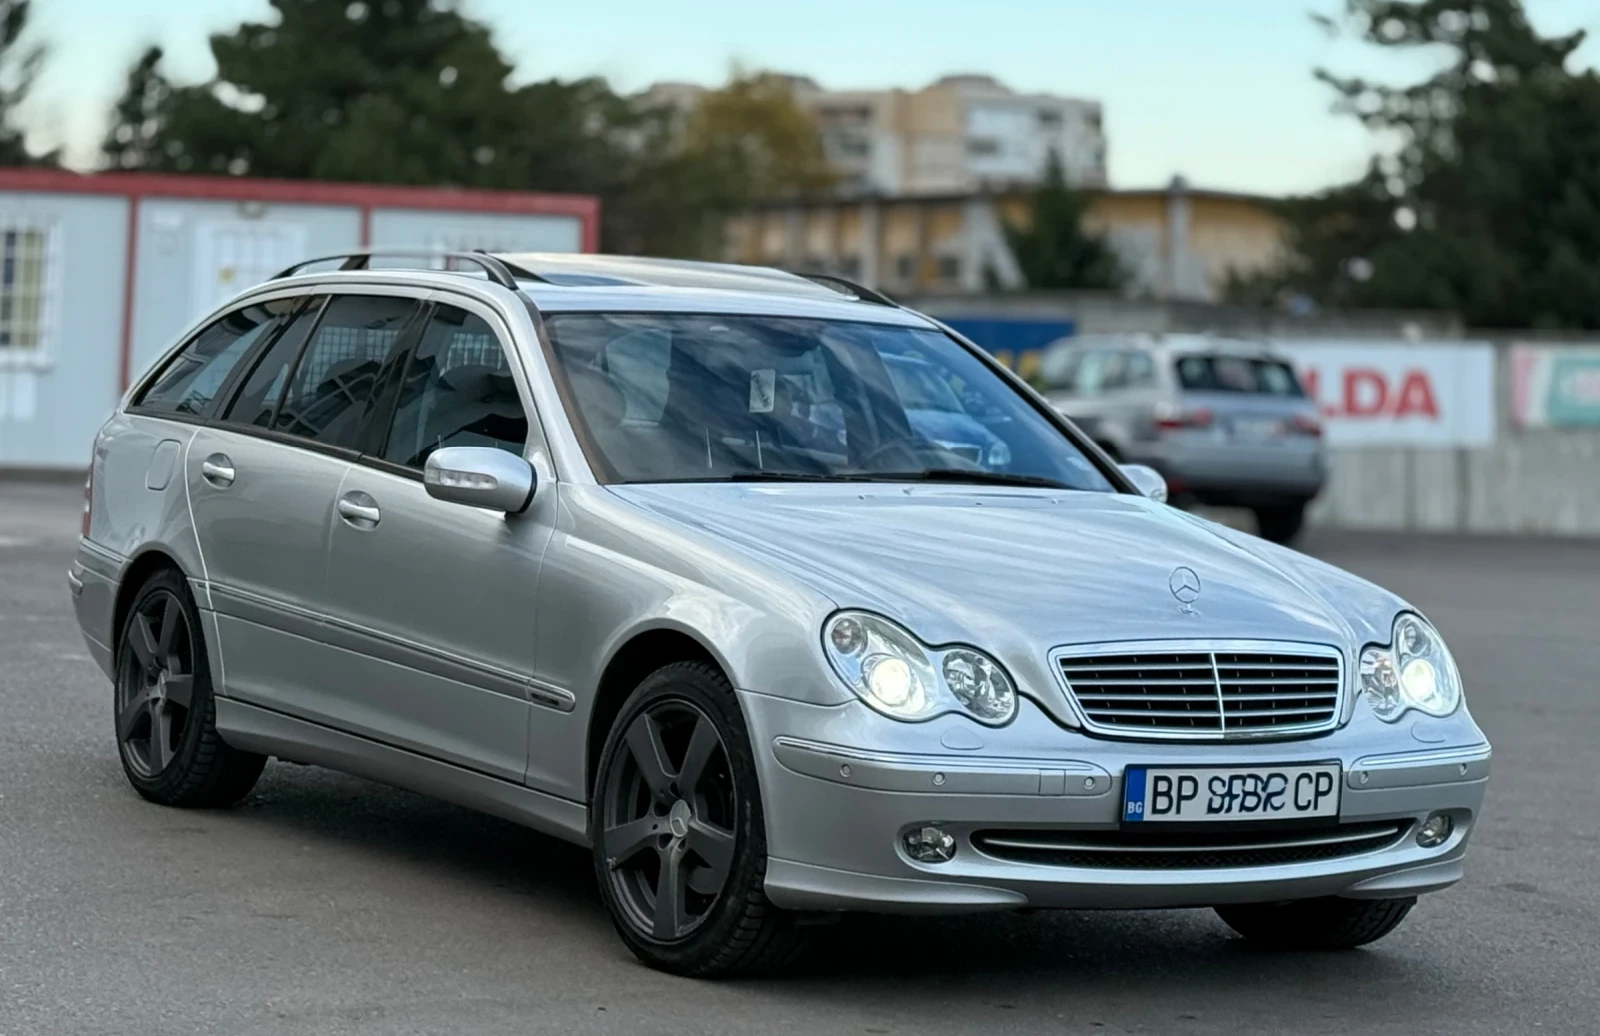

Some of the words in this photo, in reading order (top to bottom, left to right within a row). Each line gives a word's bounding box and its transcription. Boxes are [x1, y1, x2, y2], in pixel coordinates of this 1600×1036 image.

[1151, 775, 1199, 815] BP
[1294, 771, 1333, 811] CP
[1127, 801, 1143, 814] BG
